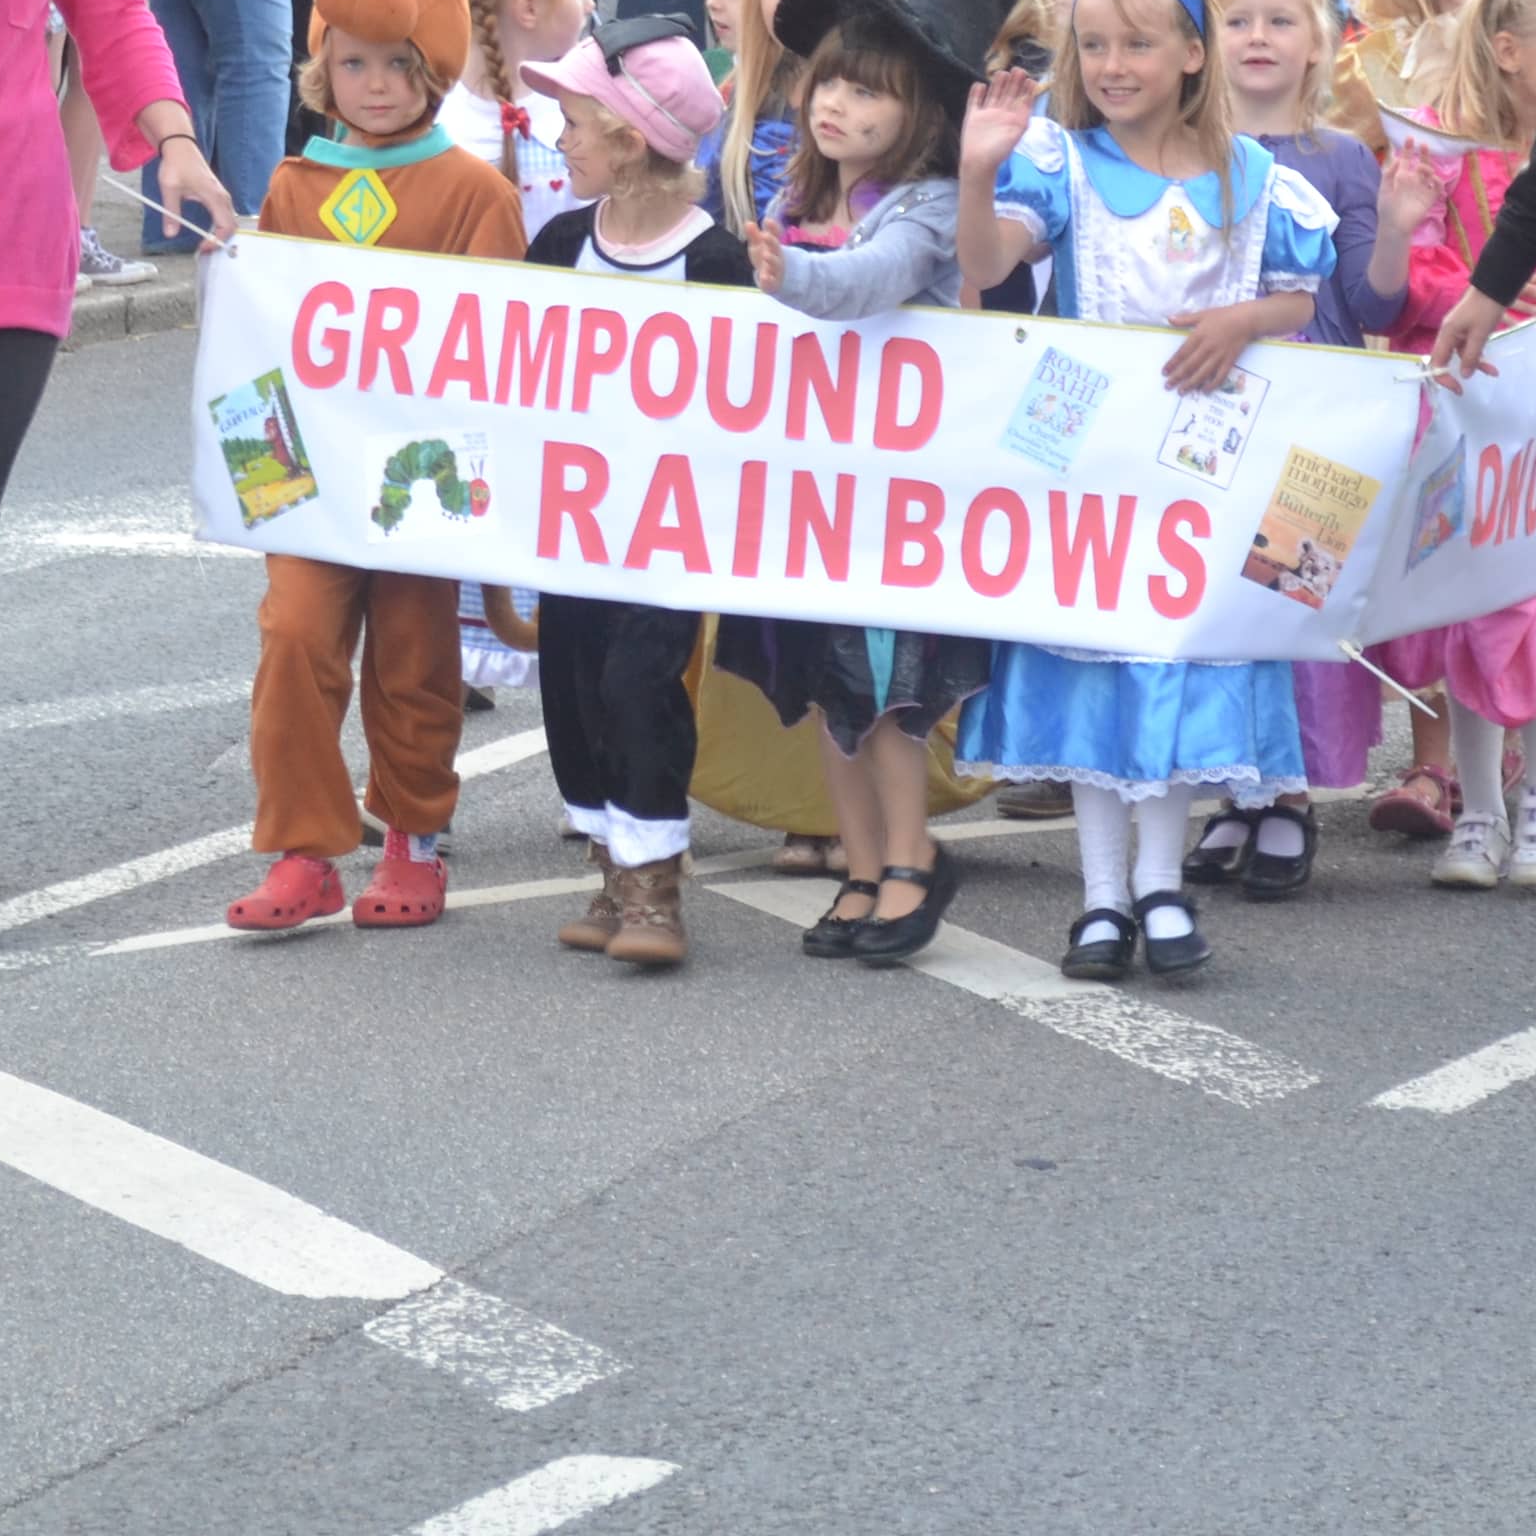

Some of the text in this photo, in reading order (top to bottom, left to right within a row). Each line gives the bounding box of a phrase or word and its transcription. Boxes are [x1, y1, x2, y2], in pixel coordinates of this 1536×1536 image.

[292, 281, 943, 451] GRAMPOUND
[1038, 364, 1099, 409] DAHL
[1045, 350, 1109, 390] ROALD
[537, 441, 1212, 619] RAINBOWS
